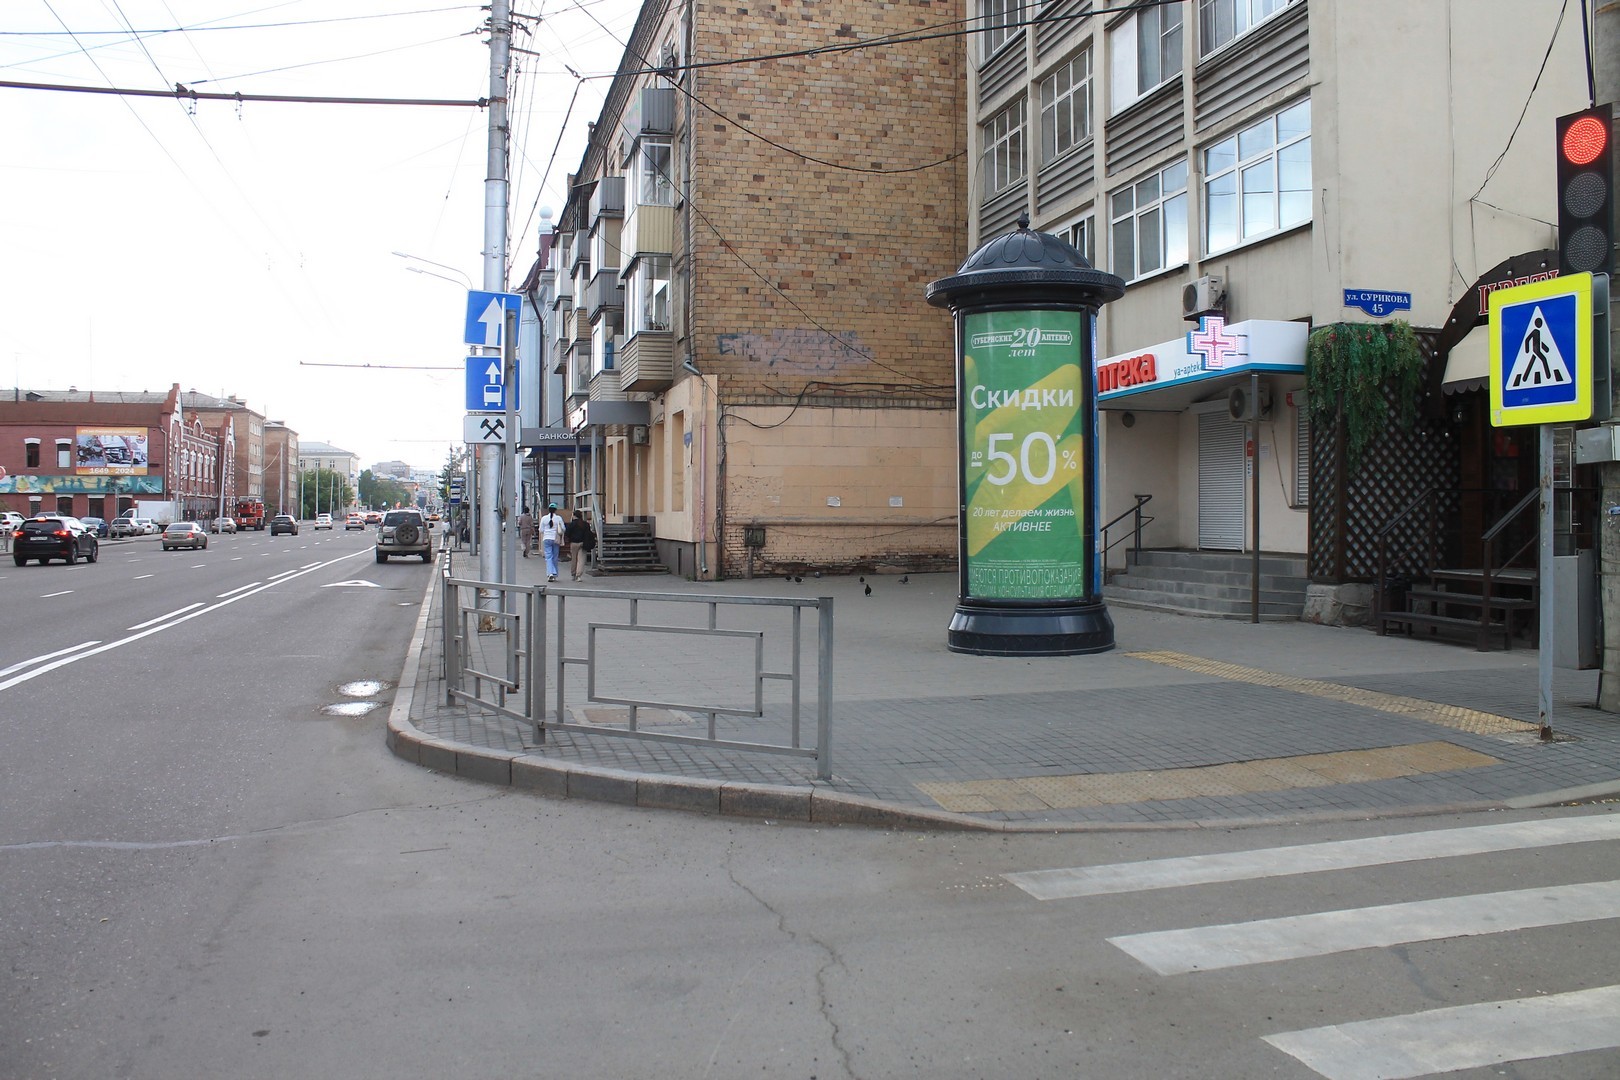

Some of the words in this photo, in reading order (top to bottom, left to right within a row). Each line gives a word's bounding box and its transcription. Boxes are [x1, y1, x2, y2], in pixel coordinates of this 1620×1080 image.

[1360, 293, 1409, 304] СУРИКОВА
[1372, 303, 1384, 314] 45
[974, 334, 1012, 345] ГУБЕРНСКИЕ
[1010, 327, 1041, 348] 20
[1041, 333, 1068, 342] АПТЕКИ
[1008, 348, 1036, 358] лет
[1097, 353, 1157, 392] птека
[1173, 361, 1201, 379] ya-aptek
[970, 384, 1074, 411] Скидки
[971, 451, 983, 460] до
[973, 507, 984, 517] 20
[984, 509, 1000, 517] лет
[1001, 509, 1043, 518] делаем
[1044, 508, 1075, 517] жизнь
[993, 521, 1052, 532] АКТИВНЕЕ
[998, 567, 1082, 585] ПРОТИВОПОКАЗАНИЯ
